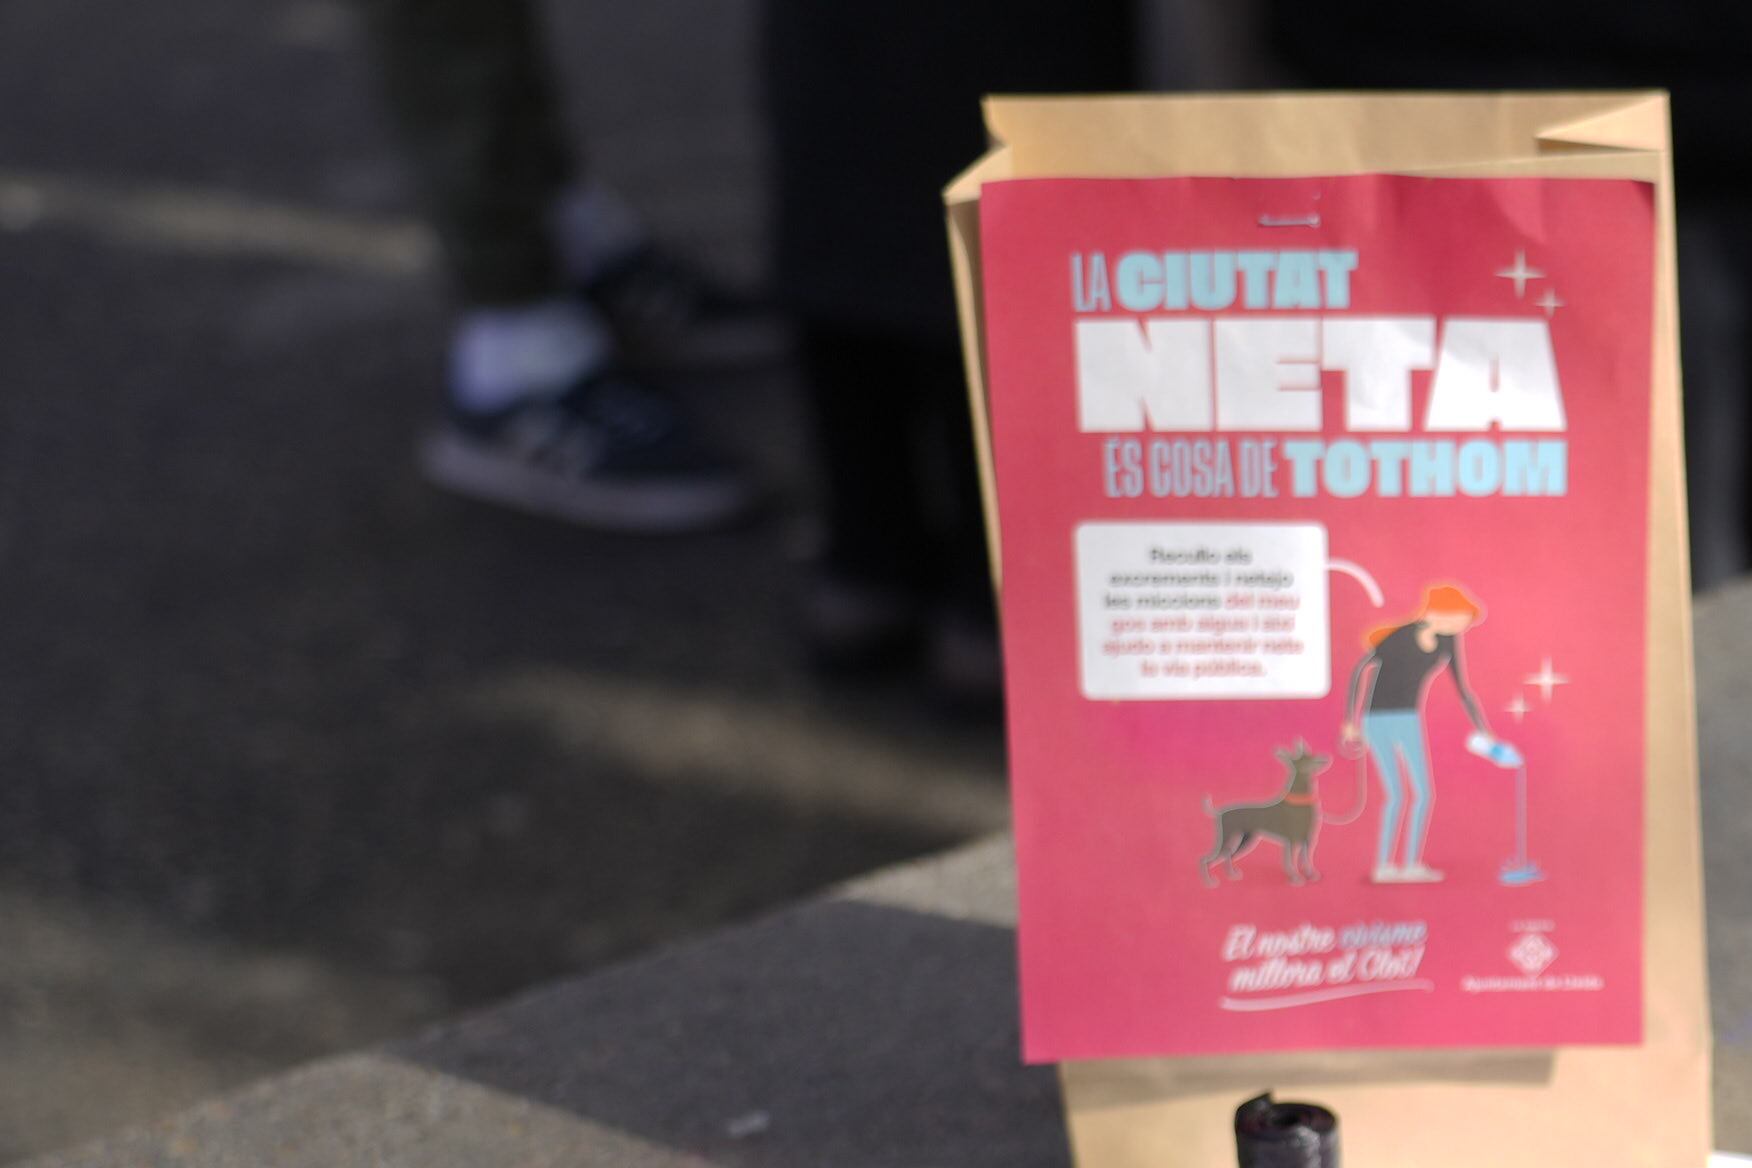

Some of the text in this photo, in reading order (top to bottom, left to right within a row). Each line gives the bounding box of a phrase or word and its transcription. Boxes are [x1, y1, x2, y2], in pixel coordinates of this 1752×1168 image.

[1070, 249, 1359, 312] LA CIUTAT
[1074, 316, 1567, 432] NETA
[1149, 439, 1236, 498] COSA
[1239, 439, 1279, 498] DE
[1282, 438, 1567, 496] TOTHOM
